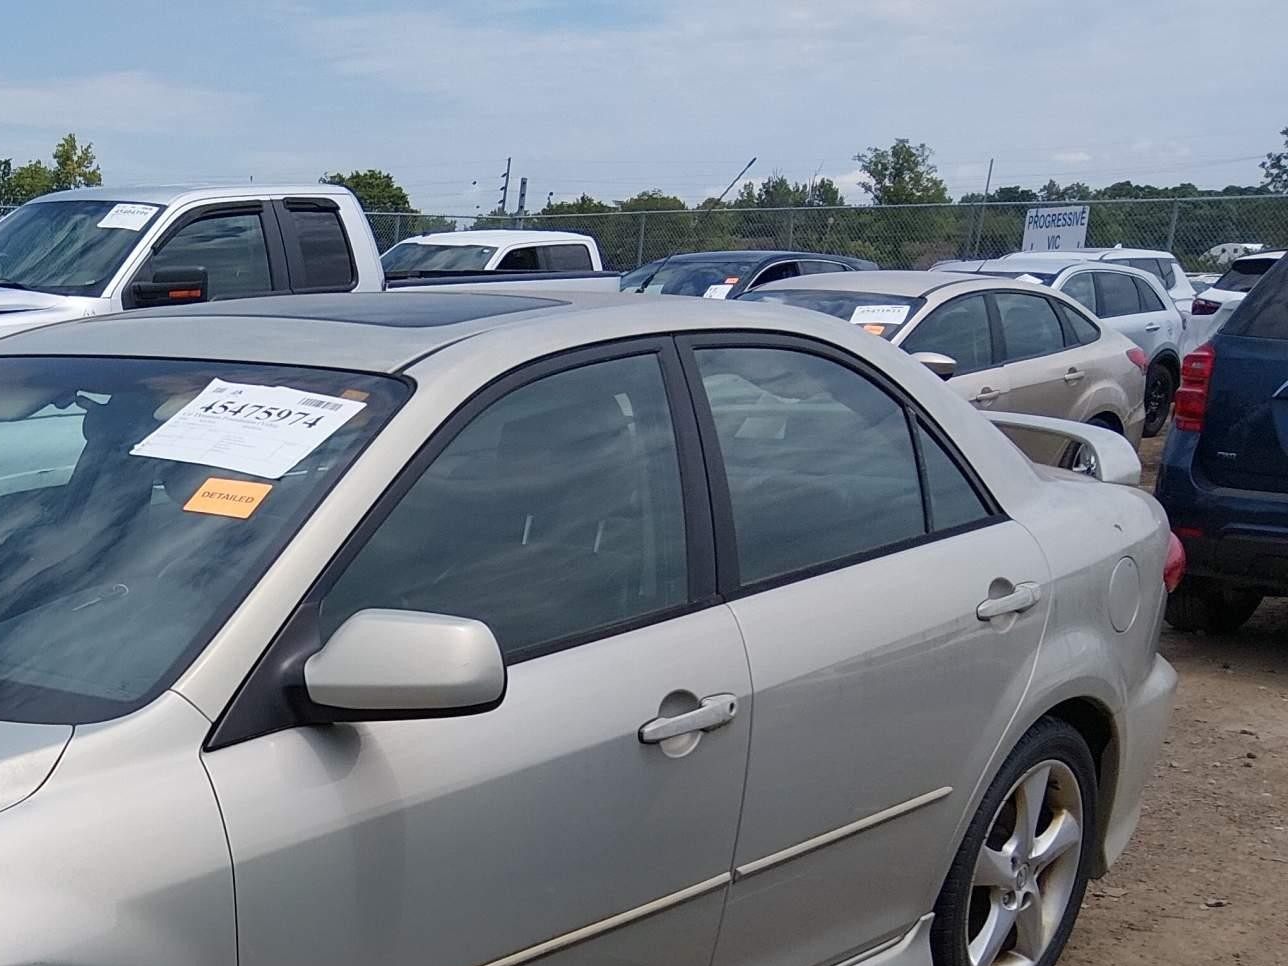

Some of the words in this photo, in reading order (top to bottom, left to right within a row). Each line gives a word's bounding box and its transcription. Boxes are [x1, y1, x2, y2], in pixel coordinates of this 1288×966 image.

[1027, 210, 1086, 230] PROGRESSIVE
[1047, 235, 1061, 250] VIC
[200, 400, 325, 429] 45475974
[201, 490, 256, 505] DETAILED
